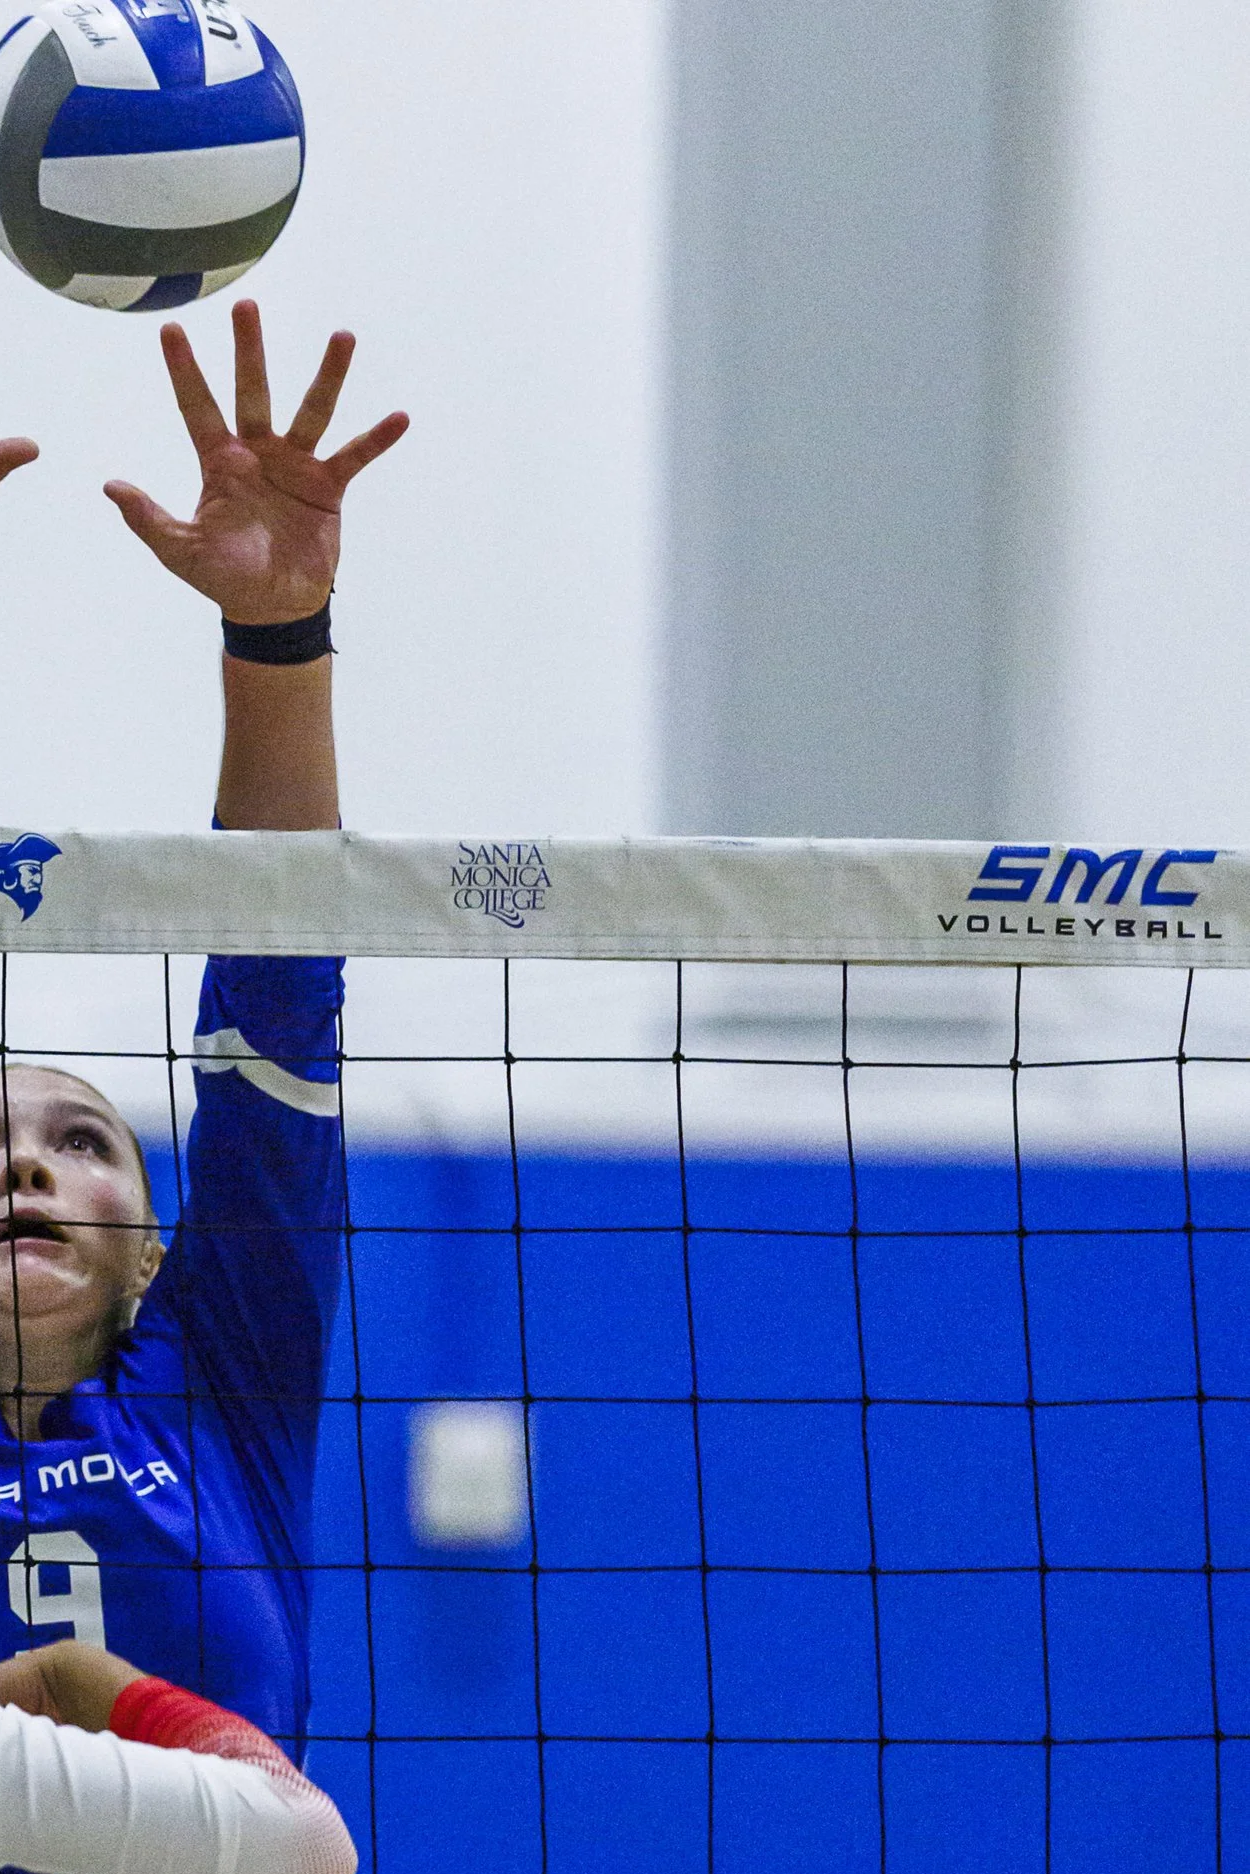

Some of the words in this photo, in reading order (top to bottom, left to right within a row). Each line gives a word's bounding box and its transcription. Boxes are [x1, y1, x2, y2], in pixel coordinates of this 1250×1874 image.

[458, 840, 545, 865] SANTA
[451, 866, 552, 887] MONICA
[967, 845, 1218, 906] SMC
[454, 889, 546, 929] COLLEGE
[938, 914, 1222, 939] VOLLEYBALL
[7, 1529, 107, 1658] 9
